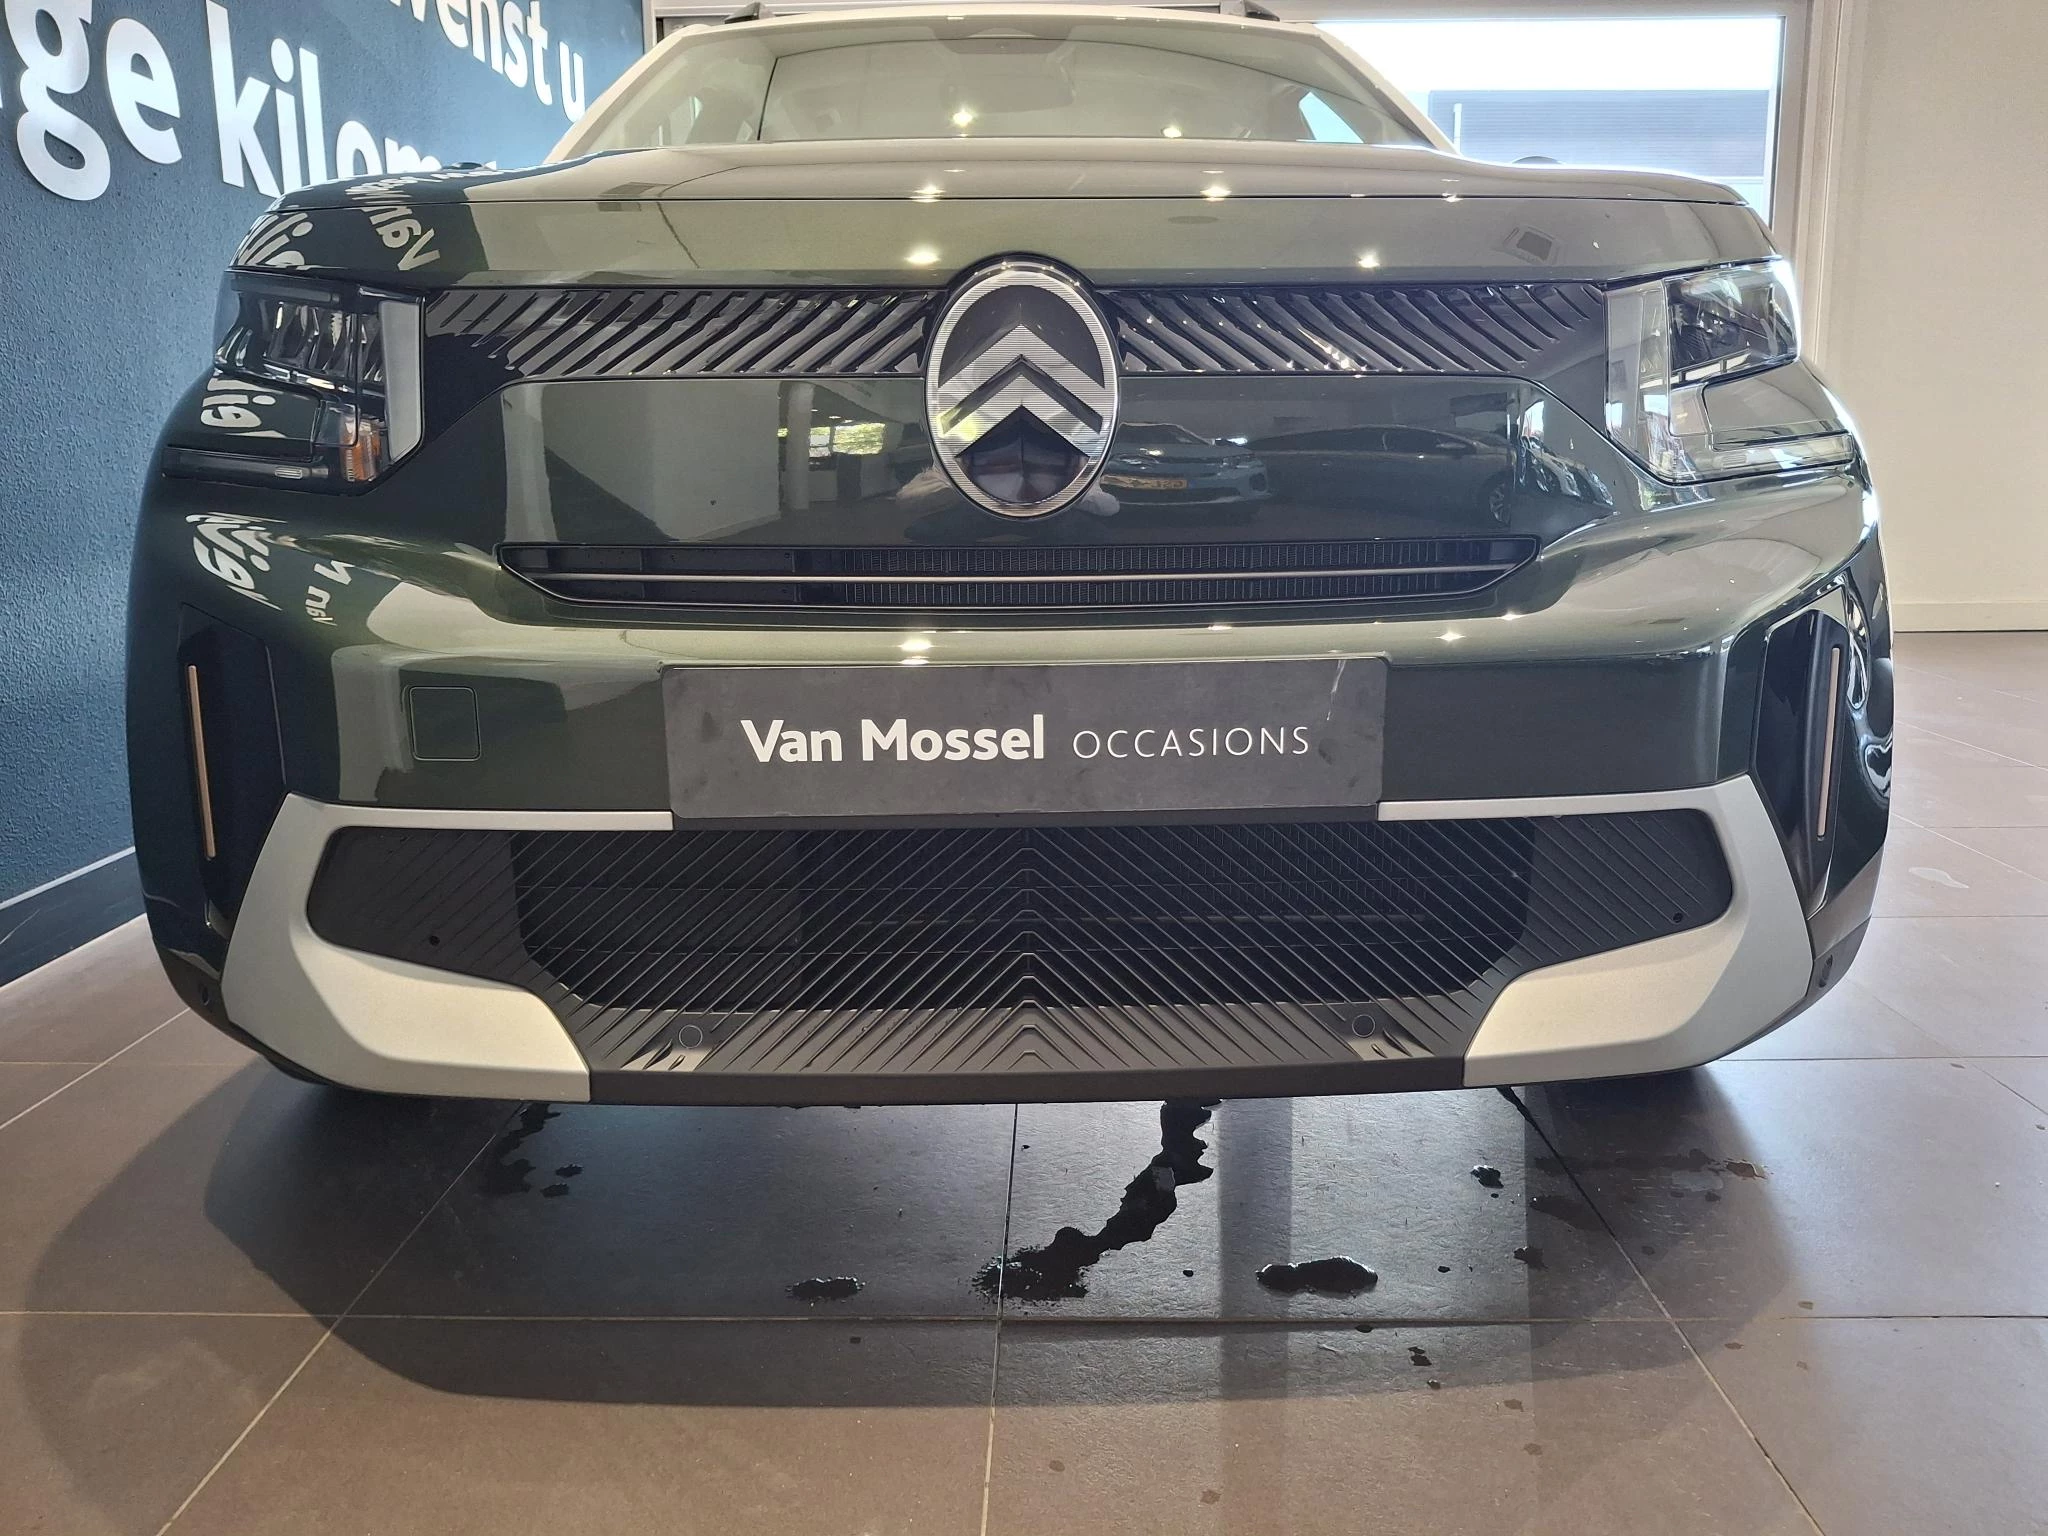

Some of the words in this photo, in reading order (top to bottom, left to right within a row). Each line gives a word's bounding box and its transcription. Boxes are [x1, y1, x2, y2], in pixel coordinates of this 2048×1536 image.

[0, 0, 184, 201] ge
[390, 0, 553, 106] enst
[559, 41, 586, 123] u
[741, 719, 842, 763] Van
[861, 714, 1044, 762] Mossel
[1072, 726, 1309, 759] OCCASIONS
